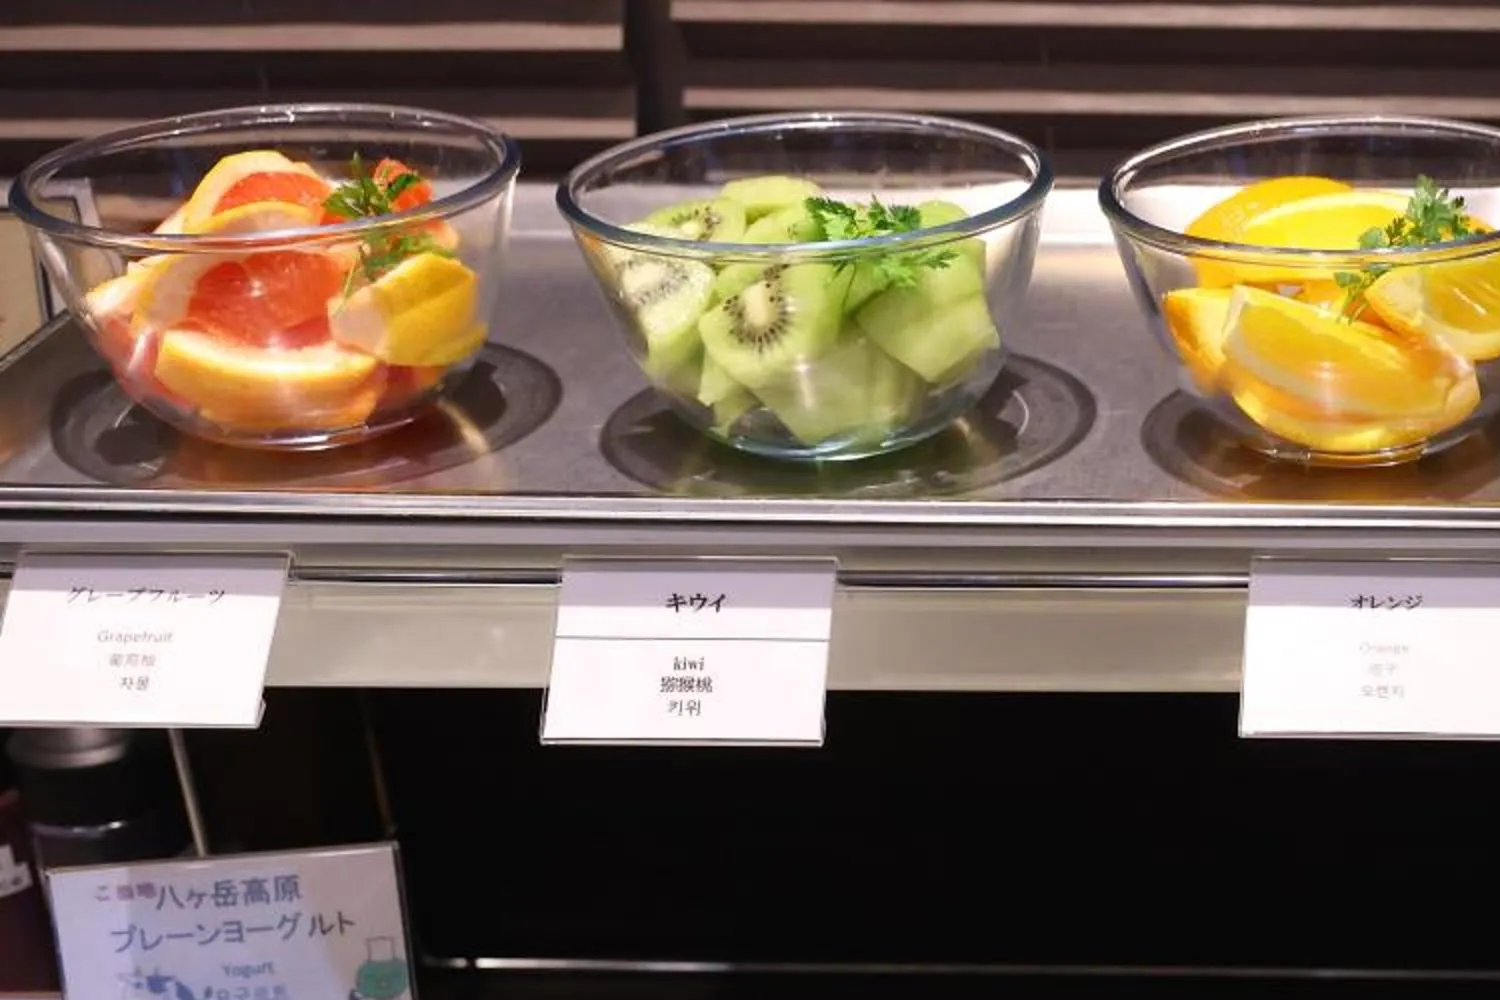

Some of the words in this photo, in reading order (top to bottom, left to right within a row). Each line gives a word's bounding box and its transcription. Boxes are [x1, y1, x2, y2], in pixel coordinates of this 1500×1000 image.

[67, 585, 226, 604] グレープフルーツ
[1350, 594, 1423, 610] オレンジ
[97, 629, 174, 645] Grapefruit
[673, 656, 705, 672] kiwi
[668, 699, 702, 716] 키위
[110, 911, 357, 954] プレーンヨーグルト
[221, 960, 275, 979] Yogurt
